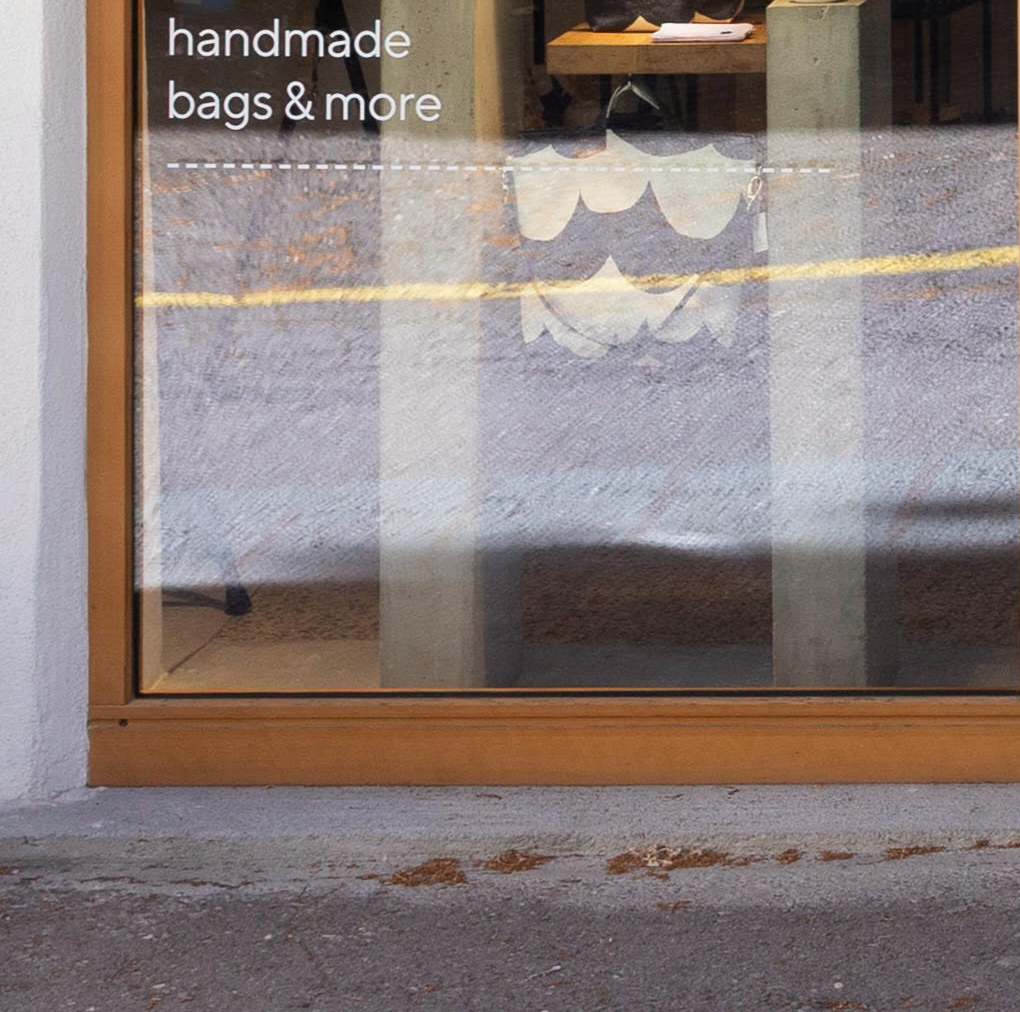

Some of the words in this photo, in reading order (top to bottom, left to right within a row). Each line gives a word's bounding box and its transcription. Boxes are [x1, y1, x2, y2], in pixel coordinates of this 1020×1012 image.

[167, 16, 412, 59] handmade
[167, 79, 273, 132] bags
[284, 80, 316, 122] &
[325, 91, 442, 123] more
